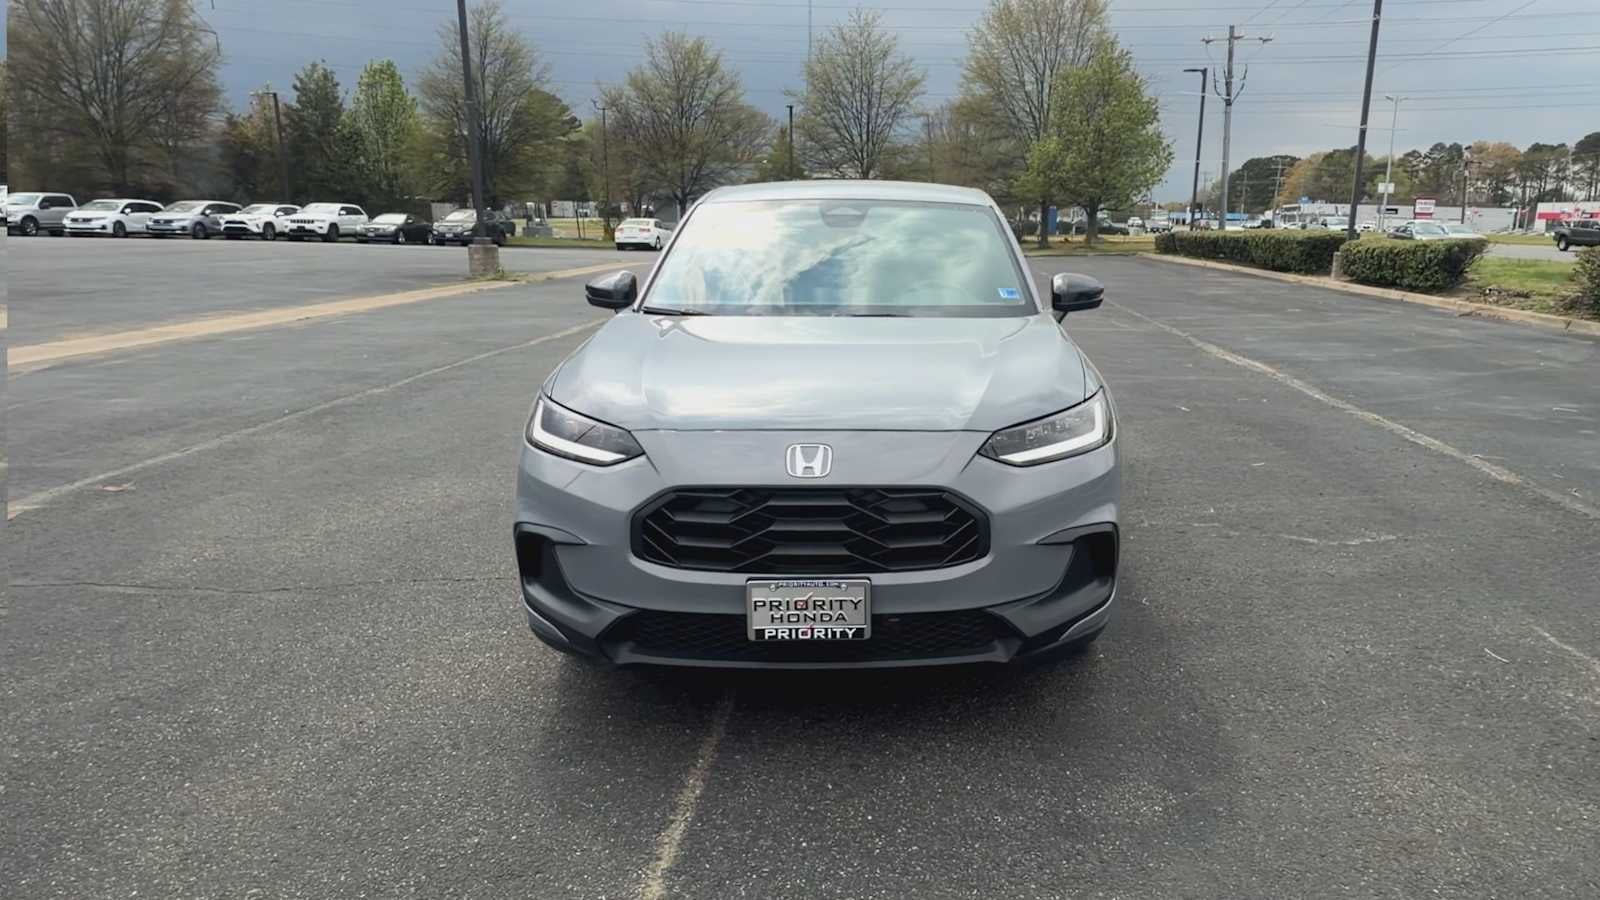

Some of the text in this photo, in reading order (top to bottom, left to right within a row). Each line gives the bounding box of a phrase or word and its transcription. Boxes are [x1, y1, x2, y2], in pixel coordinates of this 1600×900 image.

[753, 598, 863, 611] PRIORITY
[770, 612, 847, 623] HONDA
[765, 628, 856, 640] PRIORITY
